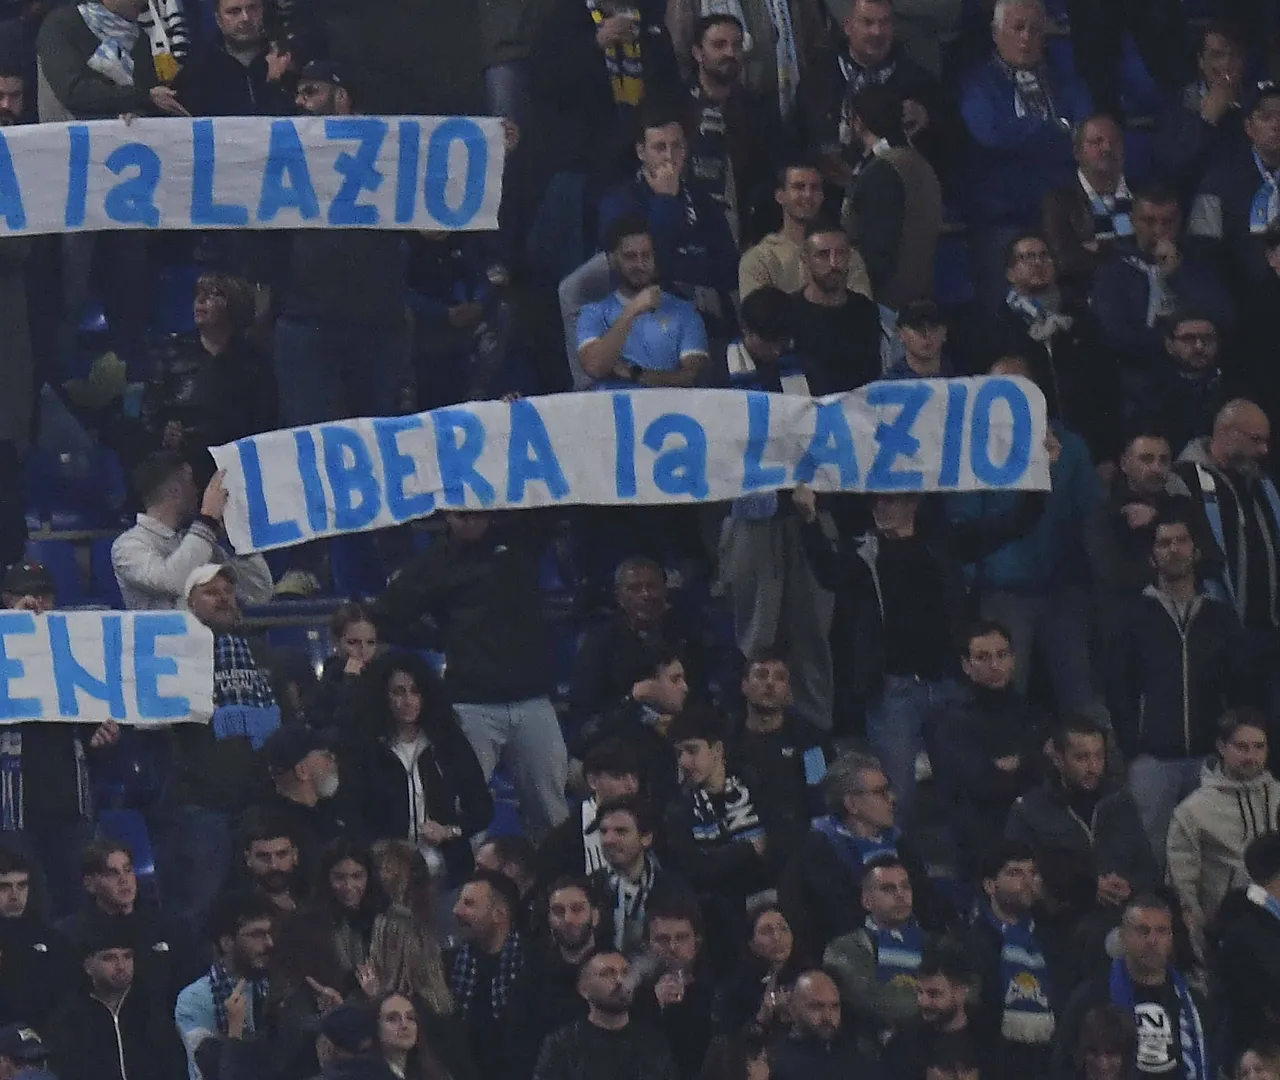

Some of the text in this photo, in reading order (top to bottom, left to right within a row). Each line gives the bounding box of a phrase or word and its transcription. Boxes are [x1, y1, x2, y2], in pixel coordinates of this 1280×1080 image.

[190, 115, 490, 229] LAZIO
[235, 396, 570, 548] LIBERA
[742, 378, 1034, 492] LAZIO
